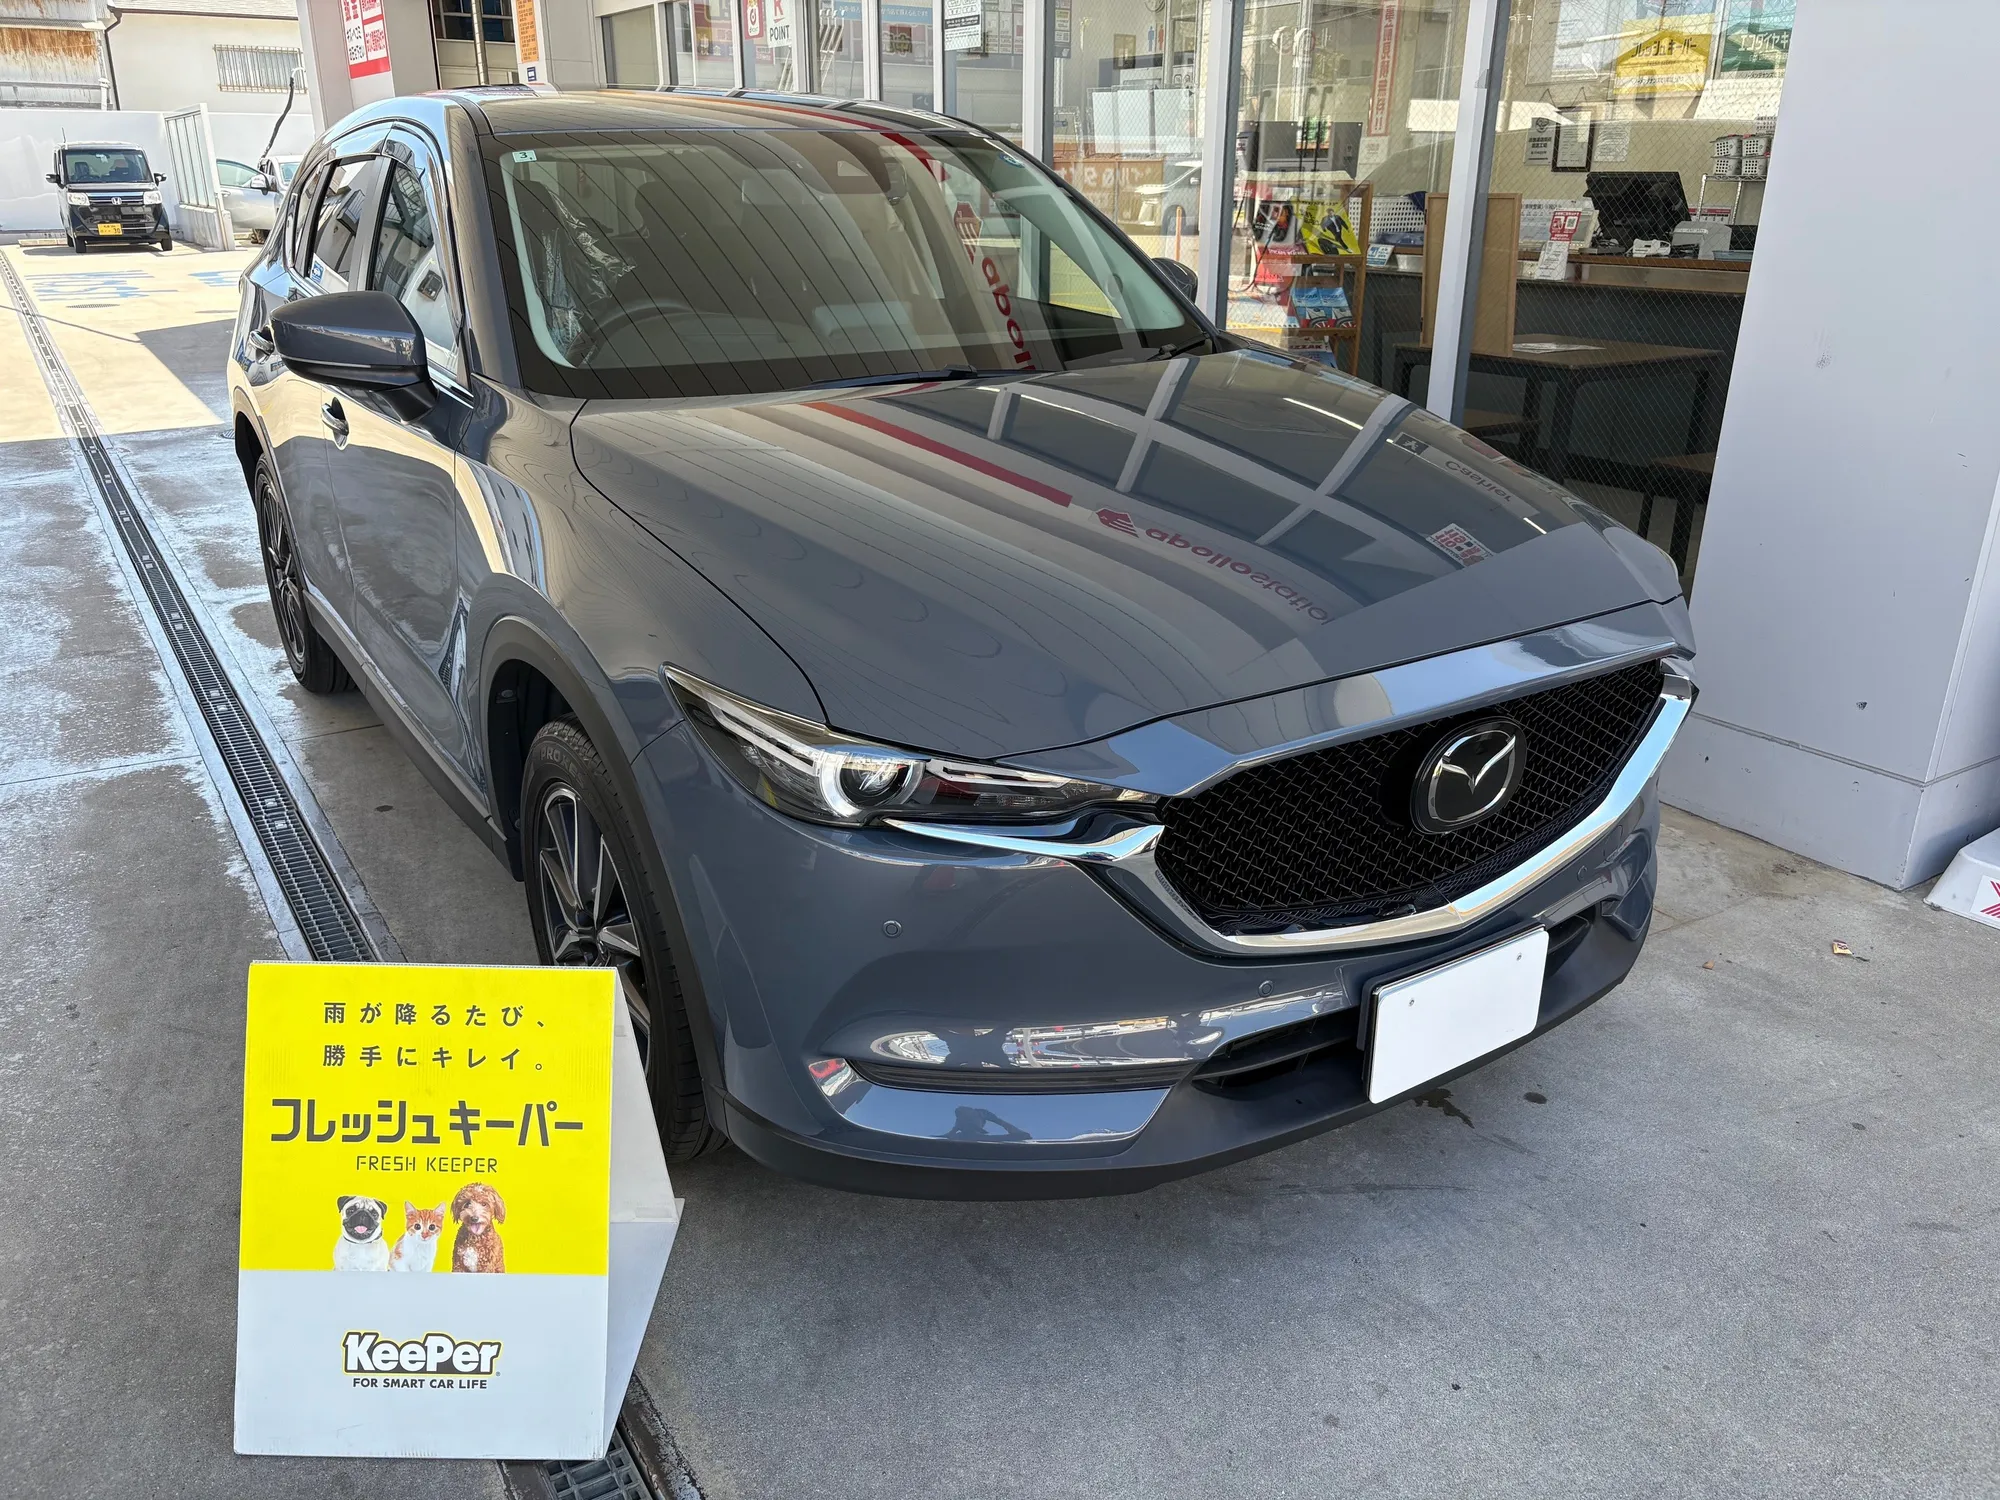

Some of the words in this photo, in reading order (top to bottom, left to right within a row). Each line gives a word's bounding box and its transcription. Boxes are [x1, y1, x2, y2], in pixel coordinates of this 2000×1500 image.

[769, 25, 790, 41] POINT
[323, 1002, 544, 1027] 雨が降るたび、
[322, 1045, 543, 1071] 勝手にキレイ。
[270, 1098, 584, 1147] フレッシュキーパー
[356, 1155, 416, 1171] FRESH
[426, 1157, 498, 1173] KEEPER
[343, 1332, 501, 1374] KeePer
[353, 1378, 378, 1388] FOR
[383, 1378, 425, 1389] SMART
[429, 1379, 454, 1389] CAR
[458, 1380, 487, 1389] LIFE
